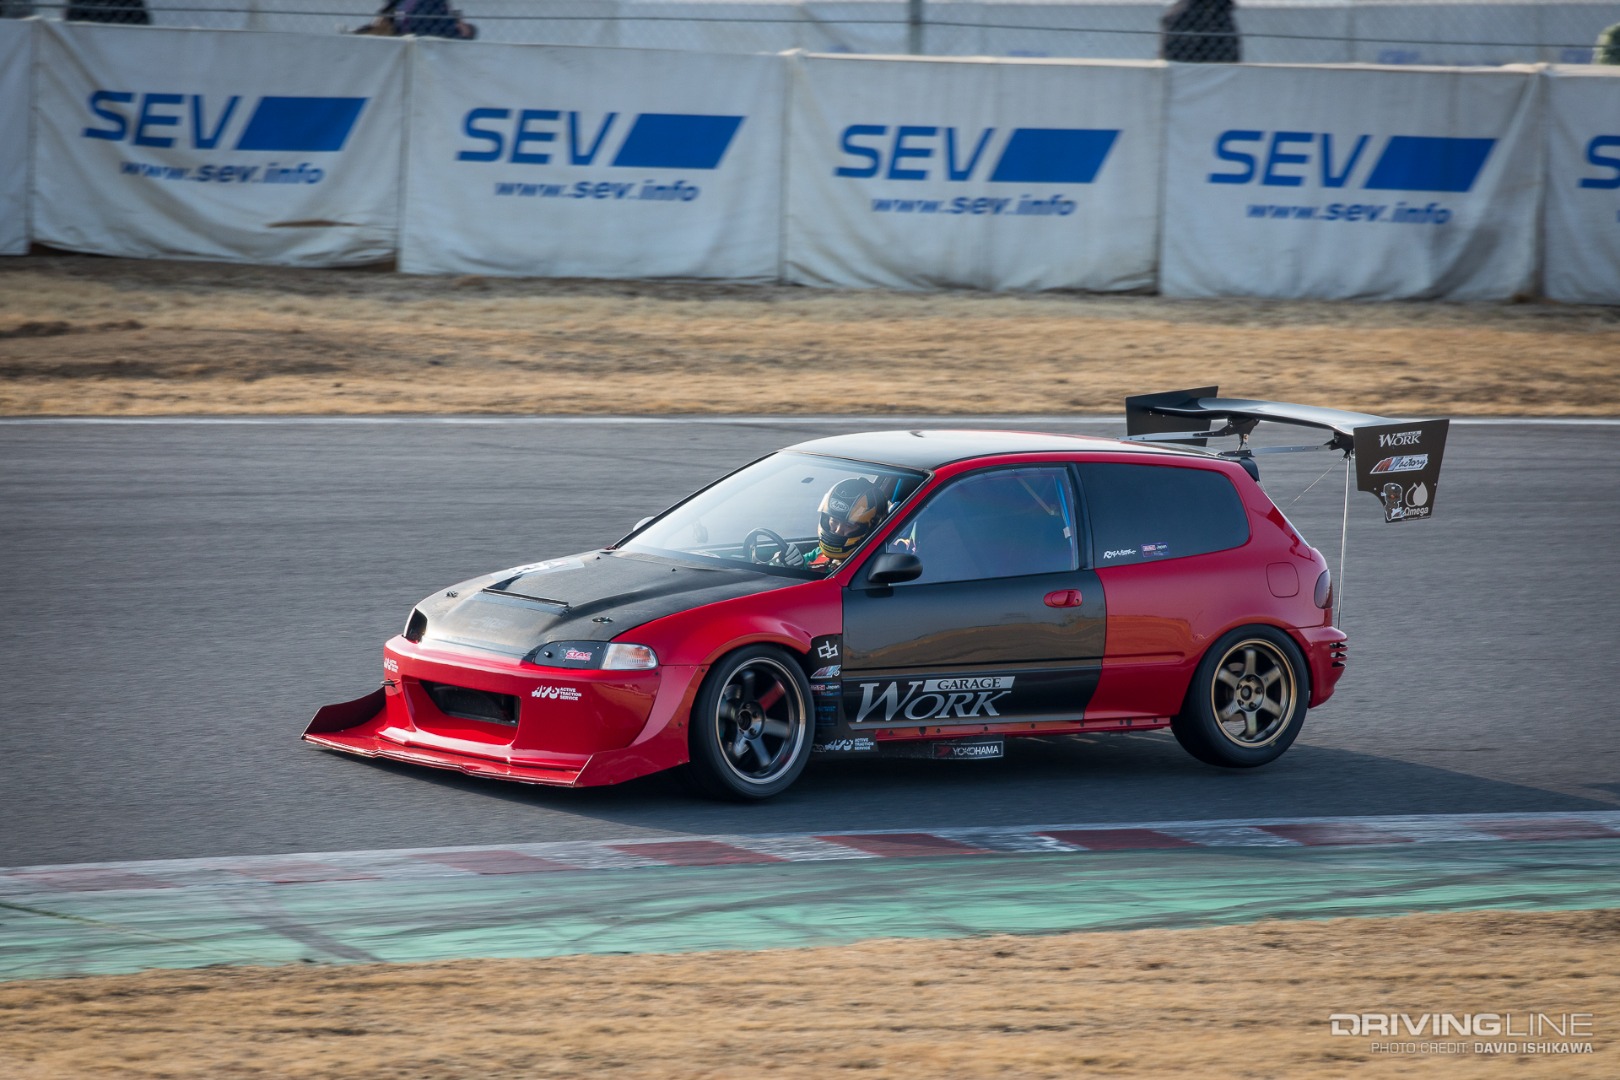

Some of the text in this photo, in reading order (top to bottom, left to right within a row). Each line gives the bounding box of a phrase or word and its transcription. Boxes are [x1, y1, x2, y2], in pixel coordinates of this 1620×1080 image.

[82, 90, 242, 150] SEV
[456, 107, 618, 167] SEV
[833, 124, 995, 183] SEV
[1207, 130, 1371, 190] SEV
[121, 161, 323, 185] www.sev.info
[495, 180, 700, 203] www.sev.info
[872, 194, 1077, 217] www.sev.info
[1248, 202, 1453, 226] www.sev.info
[1379, 433, 1421, 448] WORK
[937, 677, 1001, 691] GARAGE
[856, 681, 1012, 722] WORK
[952, 745, 999, 756] YOKOHAMA
